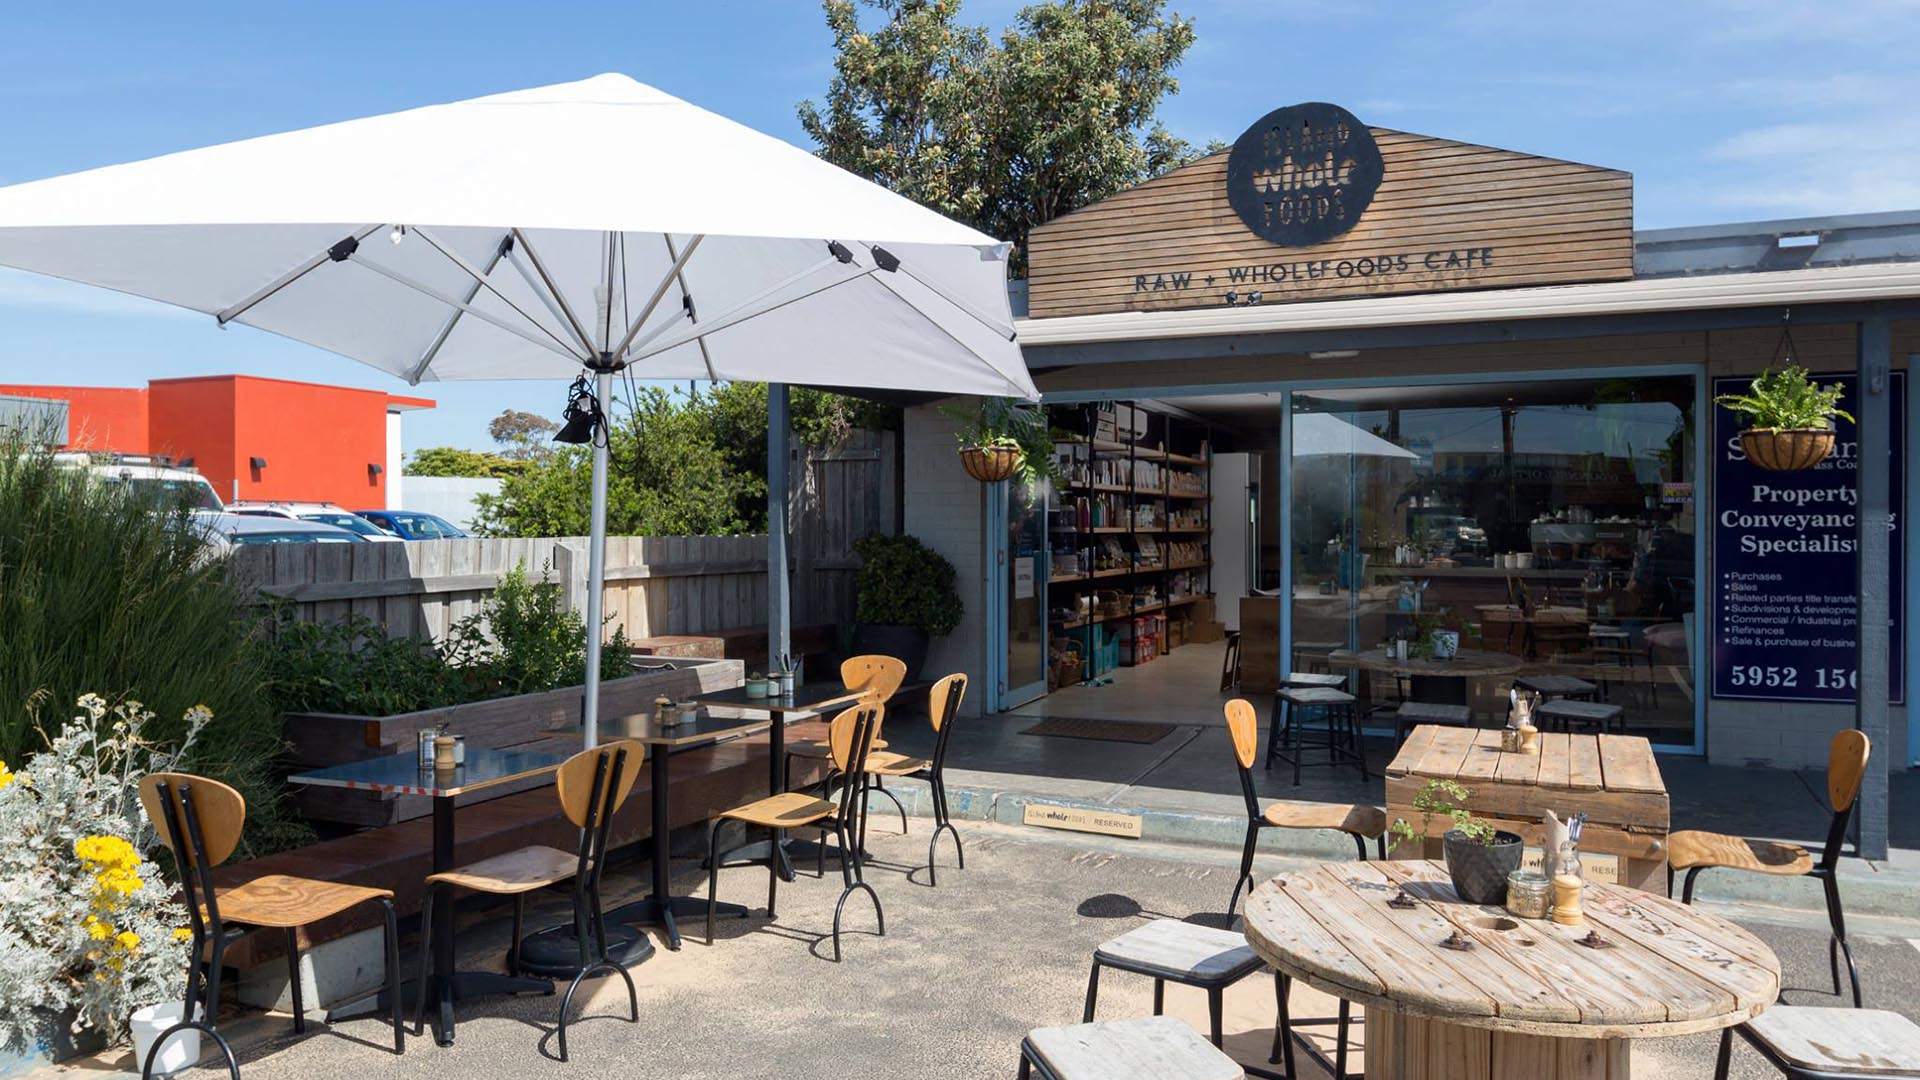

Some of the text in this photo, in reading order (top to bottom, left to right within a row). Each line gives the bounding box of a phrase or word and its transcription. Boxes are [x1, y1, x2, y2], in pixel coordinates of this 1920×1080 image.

[1263, 188, 1345, 227] FOODS
[1135, 247, 1494, 292] RAW + WHOLEFOODS CAFE
[1813, 456, 1857, 470] ass Coa
[1752, 485, 1858, 506] Property
[1731, 572, 1783, 582] Purchases
[1731, 583, 1758, 592] Sales
[1731, 594, 1857, 605] Related parties title transfe
[1731, 605, 1857, 615] Subdivisions & developme
[1731, 615, 1789, 625] Commercial
[1797, 616, 1841, 626] Industrial
[1731, 626, 1785, 635] Refinances
[1731, 637, 1856, 648] Sale & purchase of busine
[1731, 665, 1798, 687] 5952
[1047, 811, 1068, 822] whole
[1094, 818, 1133, 830] RESERVED
[1591, 865, 1617, 876] RESE
